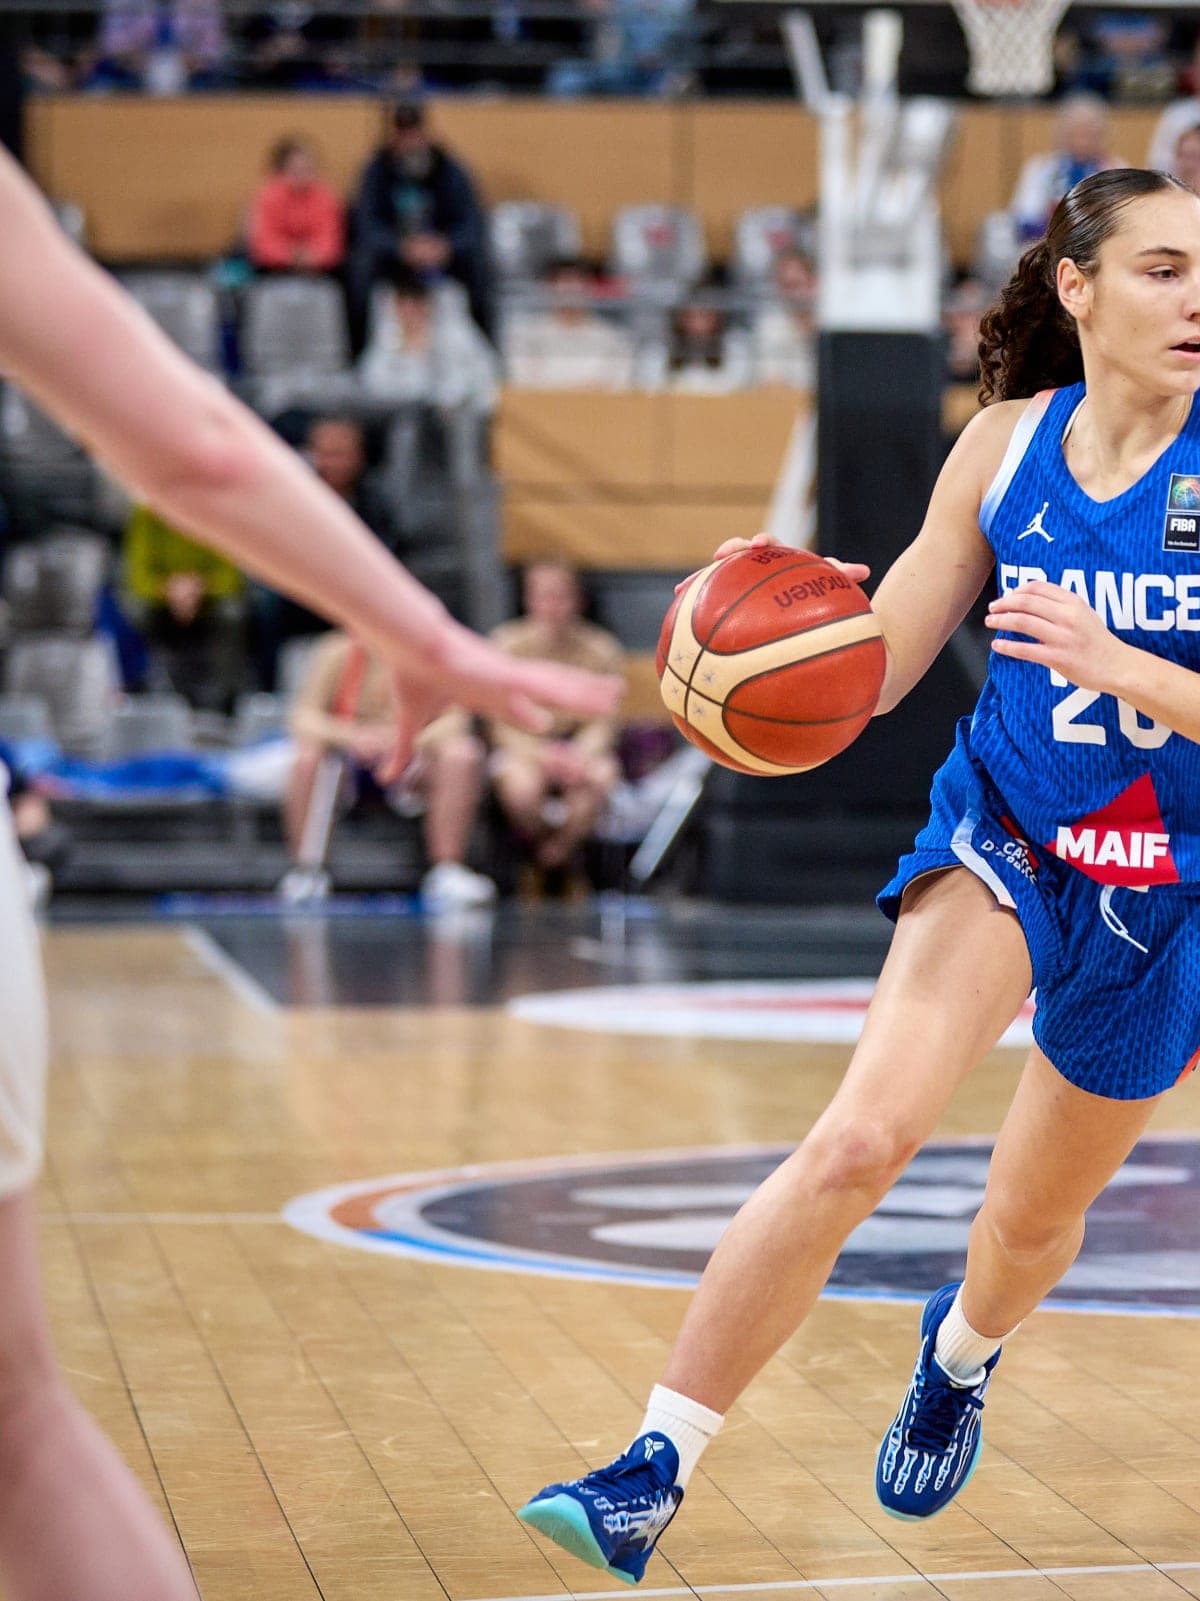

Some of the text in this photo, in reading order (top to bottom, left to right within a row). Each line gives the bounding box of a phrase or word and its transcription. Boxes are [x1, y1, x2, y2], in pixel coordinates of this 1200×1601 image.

[1170, 518, 1197, 532] FIBA
[773, 576, 852, 608] molten
[1056, 826, 1170, 868] MAIF
